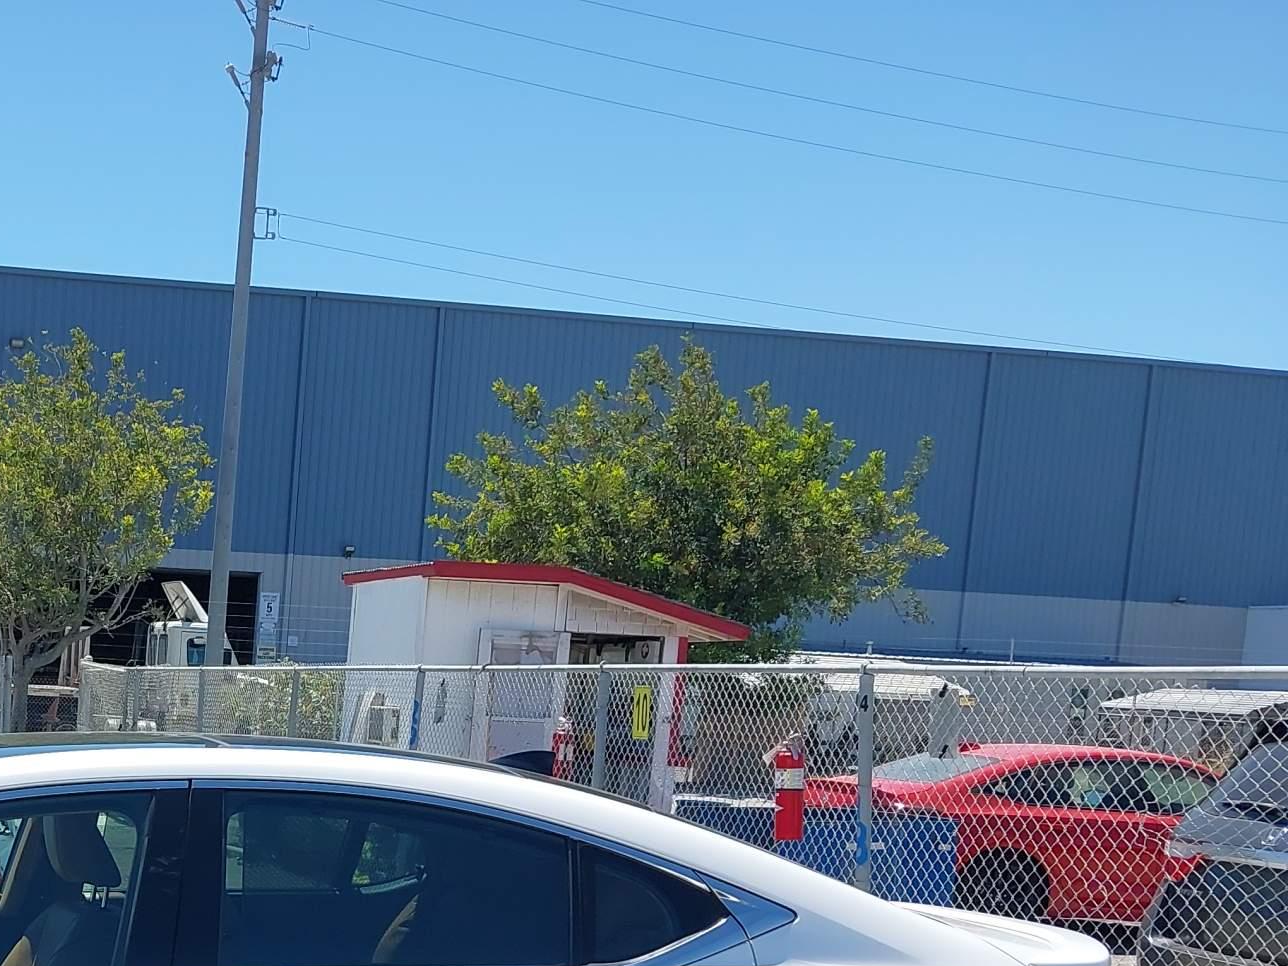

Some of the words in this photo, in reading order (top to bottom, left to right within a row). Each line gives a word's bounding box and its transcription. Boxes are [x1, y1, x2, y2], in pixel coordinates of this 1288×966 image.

[266, 602, 273, 613] 5
[636, 693, 648, 731] 10
[860, 695, 869, 712] 4
